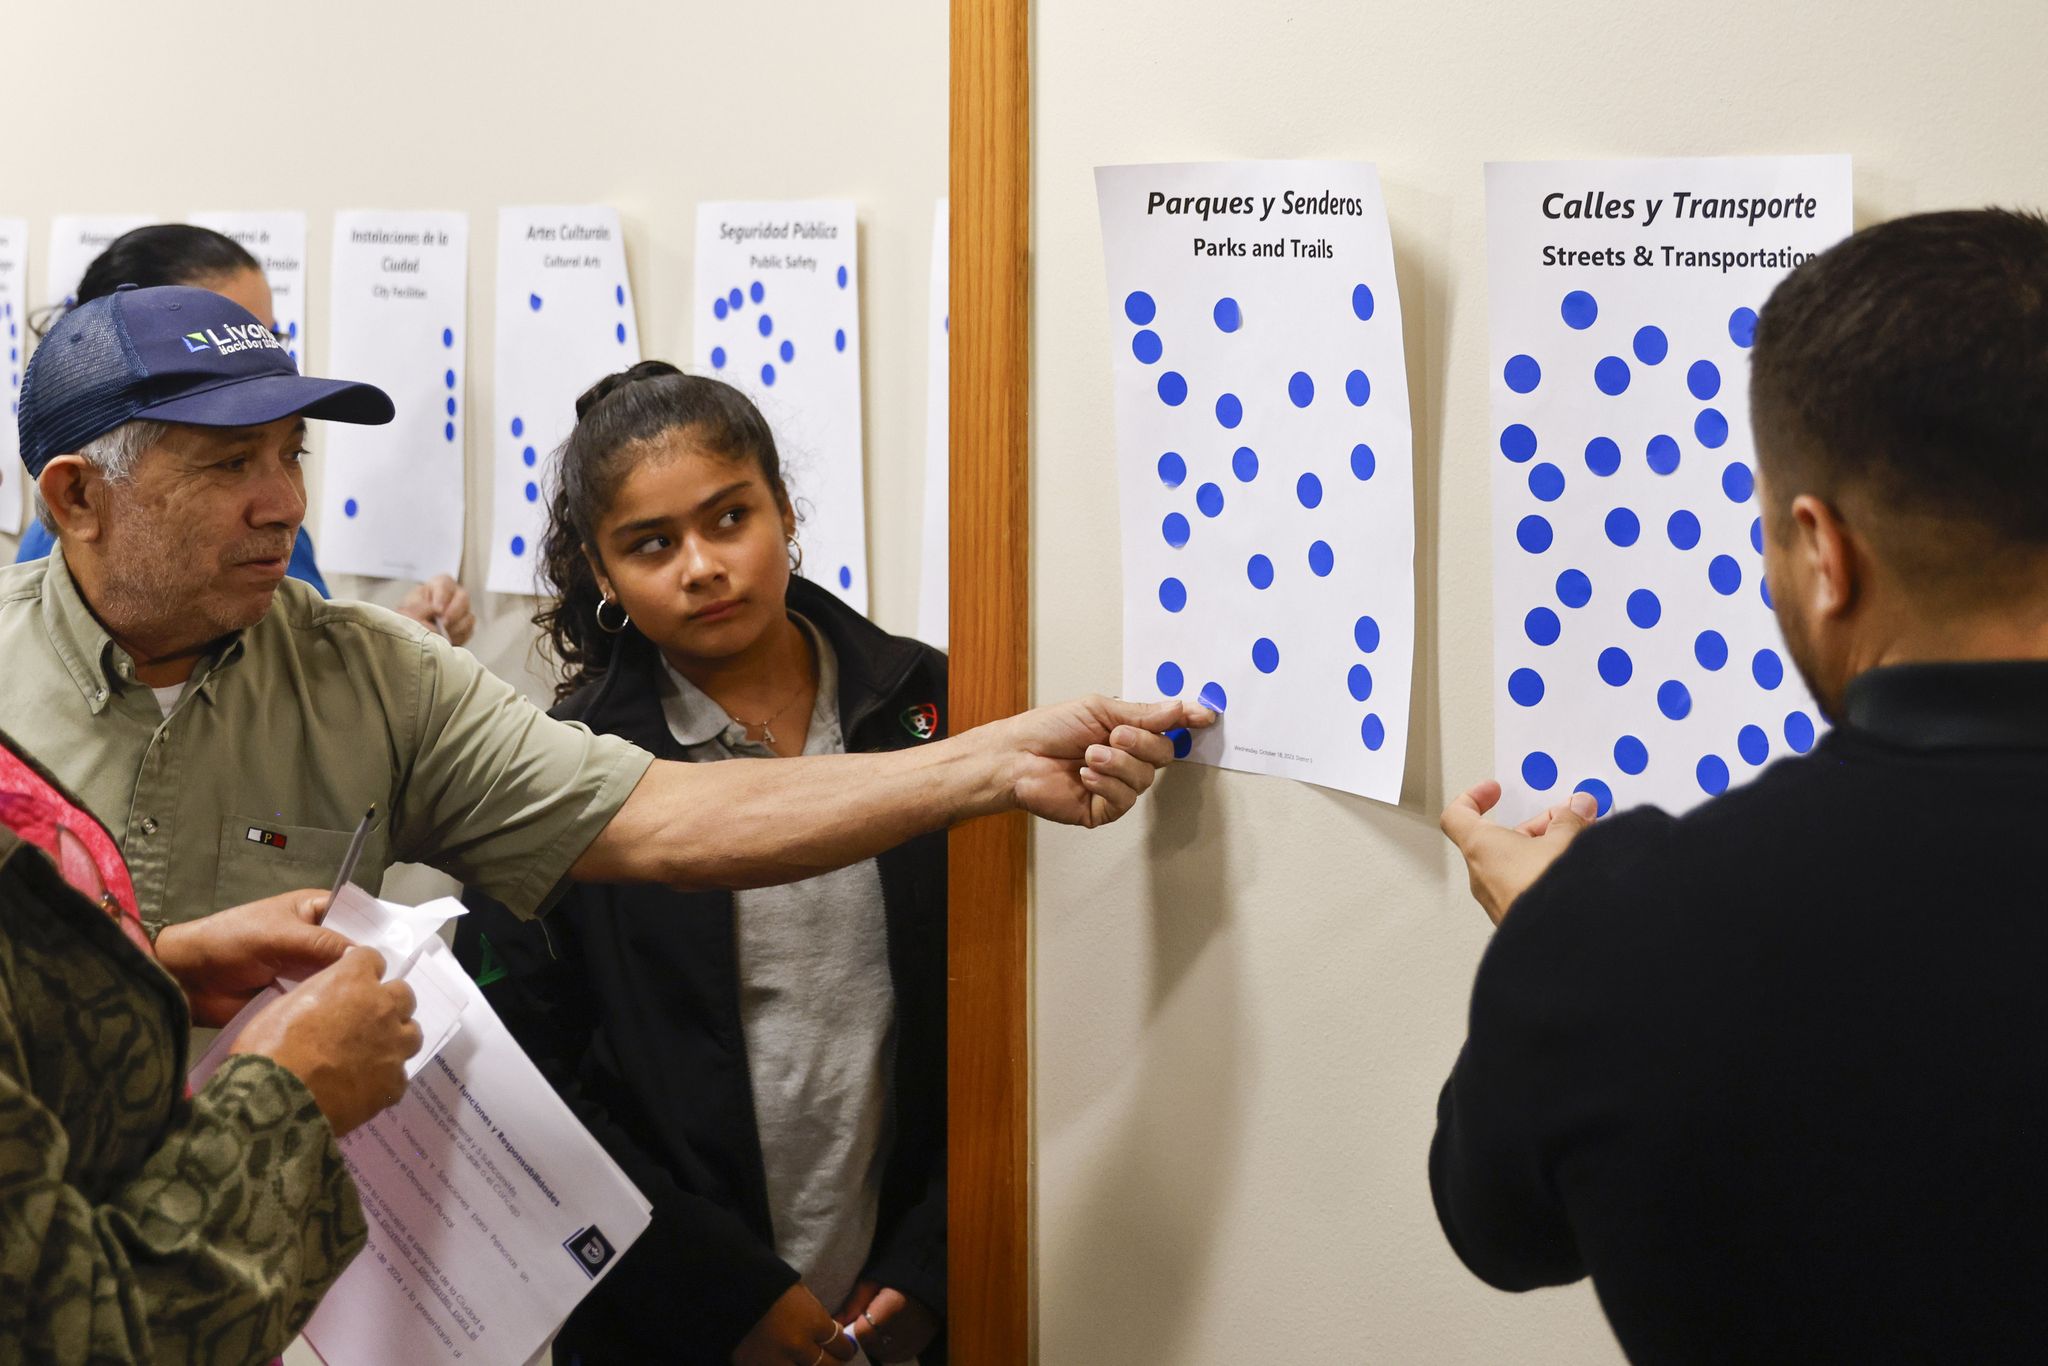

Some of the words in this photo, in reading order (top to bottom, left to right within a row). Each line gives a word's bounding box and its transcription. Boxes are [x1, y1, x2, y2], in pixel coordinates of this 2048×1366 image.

[1147, 191, 1254, 222] Parques
[1259, 196, 1276, 222] y
[1281, 189, 1363, 217] Senderos
[1542, 191, 1636, 220] Calles
[1641, 199, 1664, 227] y
[1672, 191, 1817, 227] Transporte
[351, 229, 420, 245] Instalaciones
[422, 230, 434, 246] de
[527, 224, 556, 241] Artes
[719, 221, 789, 245] Seguridad
[1193, 237, 1247, 257] Parks
[1252, 238, 1285, 258] and
[1290, 238, 1334, 259] Trails
[1542, 244, 1626, 267] Streets
[1633, 244, 1654, 267] &
[1660, 245, 1817, 273] Transportation
[381, 256, 420, 273] Ciudad
[749, 255, 782, 269] Public
[785, 254, 817, 272] Safety
[456, 1083, 495, 1127] Funciones
[494, 1130, 562, 1209] Responsabilidades
